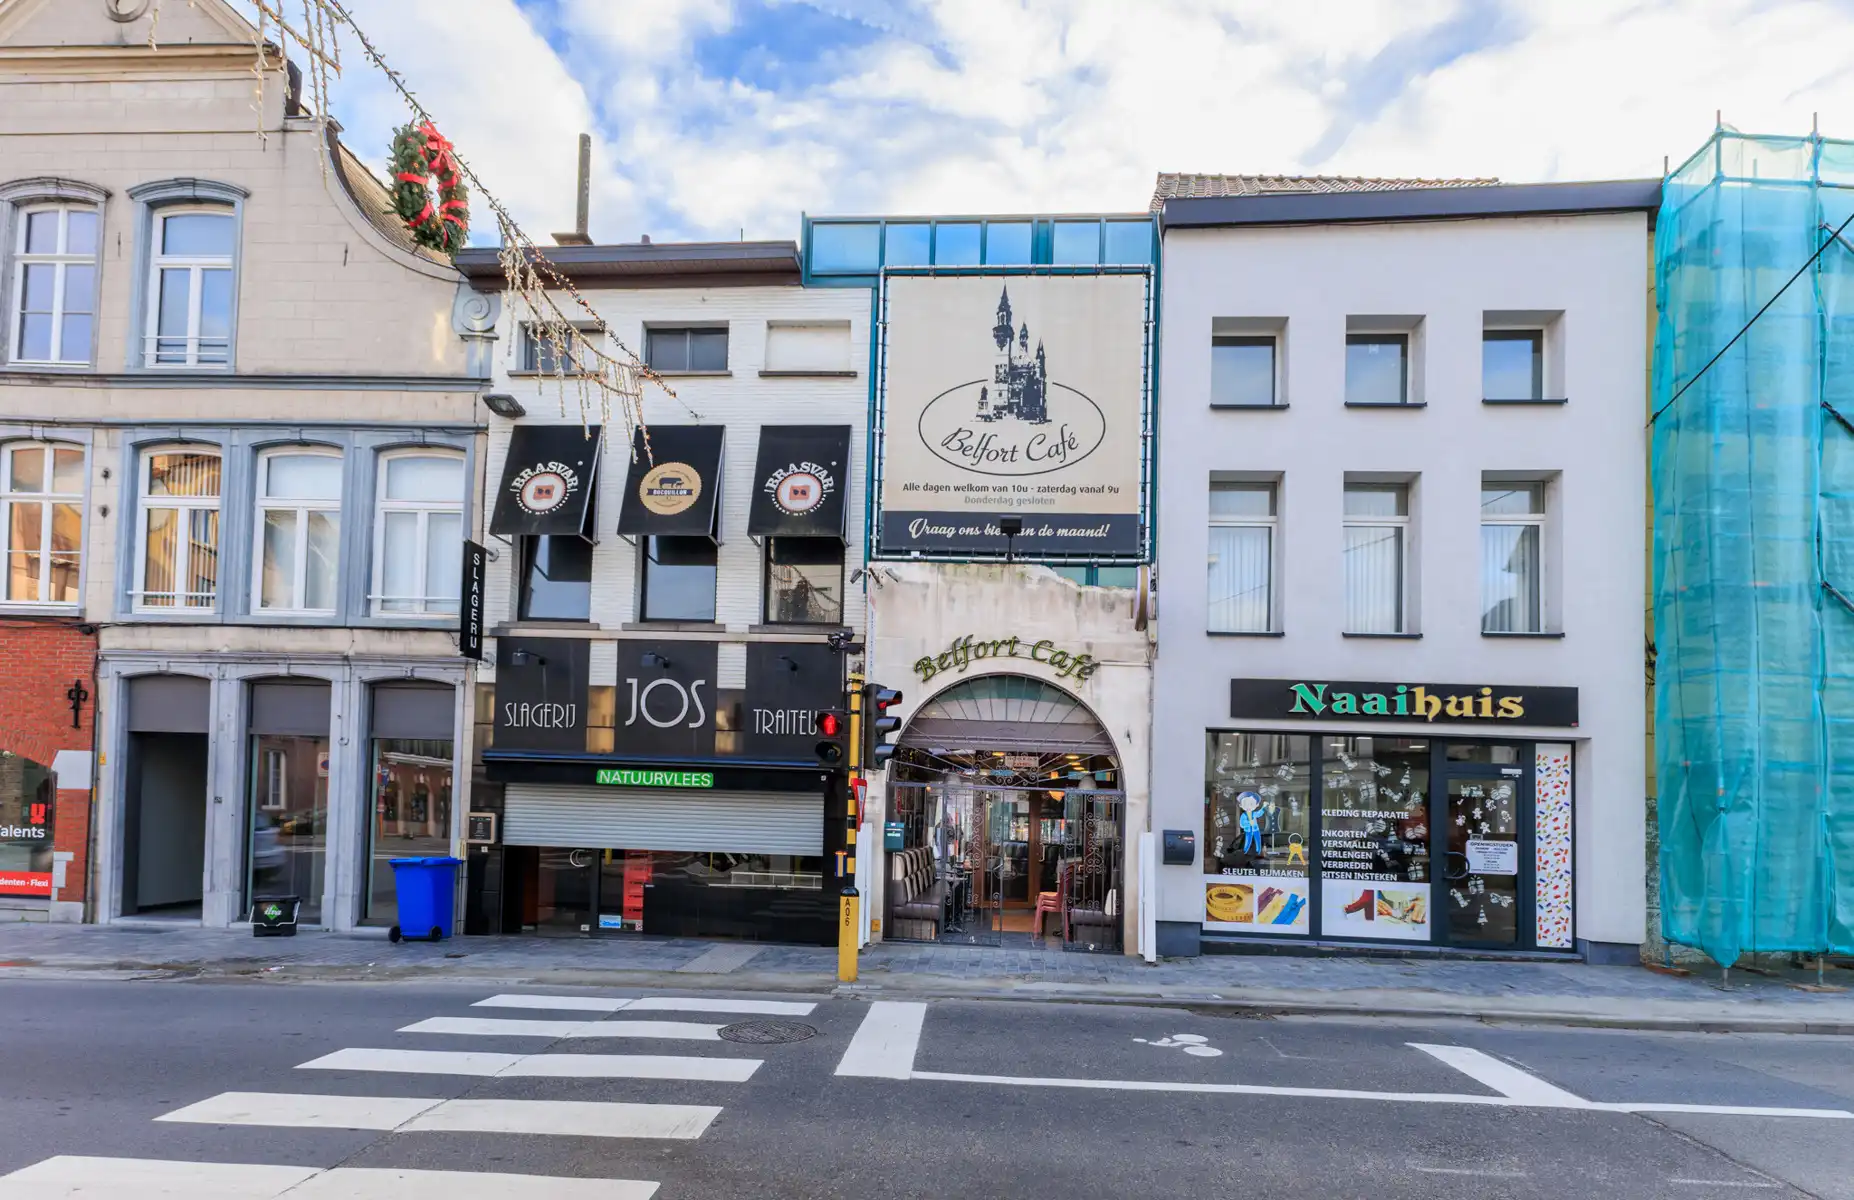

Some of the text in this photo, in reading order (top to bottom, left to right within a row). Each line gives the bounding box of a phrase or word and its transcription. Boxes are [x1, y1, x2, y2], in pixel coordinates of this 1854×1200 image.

[941, 423, 1079, 466] Belfort Café
[511, 461, 579, 490] BRASVAR
[765, 461, 834, 490] BRASVAR
[902, 483, 920, 492] Alle
[922, 483, 951, 494] dagen
[953, 484, 989, 493] welkom
[1012, 485, 1028, 493] 10u
[1037, 485, 1077, 495] zaterdag
[1079, 485, 1105, 494] vanaf
[1107, 486, 1119, 494] 9u
[964, 495, 1056, 506] Donderdag gesloten
[908, 518, 956, 539] Vraag
[958, 527, 982, 536] ons
[984, 523, 1006, 536] bie
[1038, 524, 1054, 536] de
[1056, 524, 1110, 538] maand!
[914, 634, 1020, 682] Belfort
[625, 678, 706, 728] JOS
[1288, 683, 1524, 722] Naaihuis
[504, 702, 576, 729] SLAGERIJ
[753, 709, 818, 735] TRAITEU
[598, 769, 712, 787] NATUURVLEES
[1321, 809, 1409, 820] KLEDING REPARATIE
[0, 825, 45, 838] alents
[1321, 830, 1367, 839] INKORTEN
[1321, 840, 1379, 849] VERSMALLEN
[1321, 851, 1373, 860] VERLENGEN
[1222, 867, 1257, 877] SLEUTEL
[1321, 861, 1373, 870] VERBREDEN
[1321, 871, 1397, 882] RITSEN INSTEKEN
